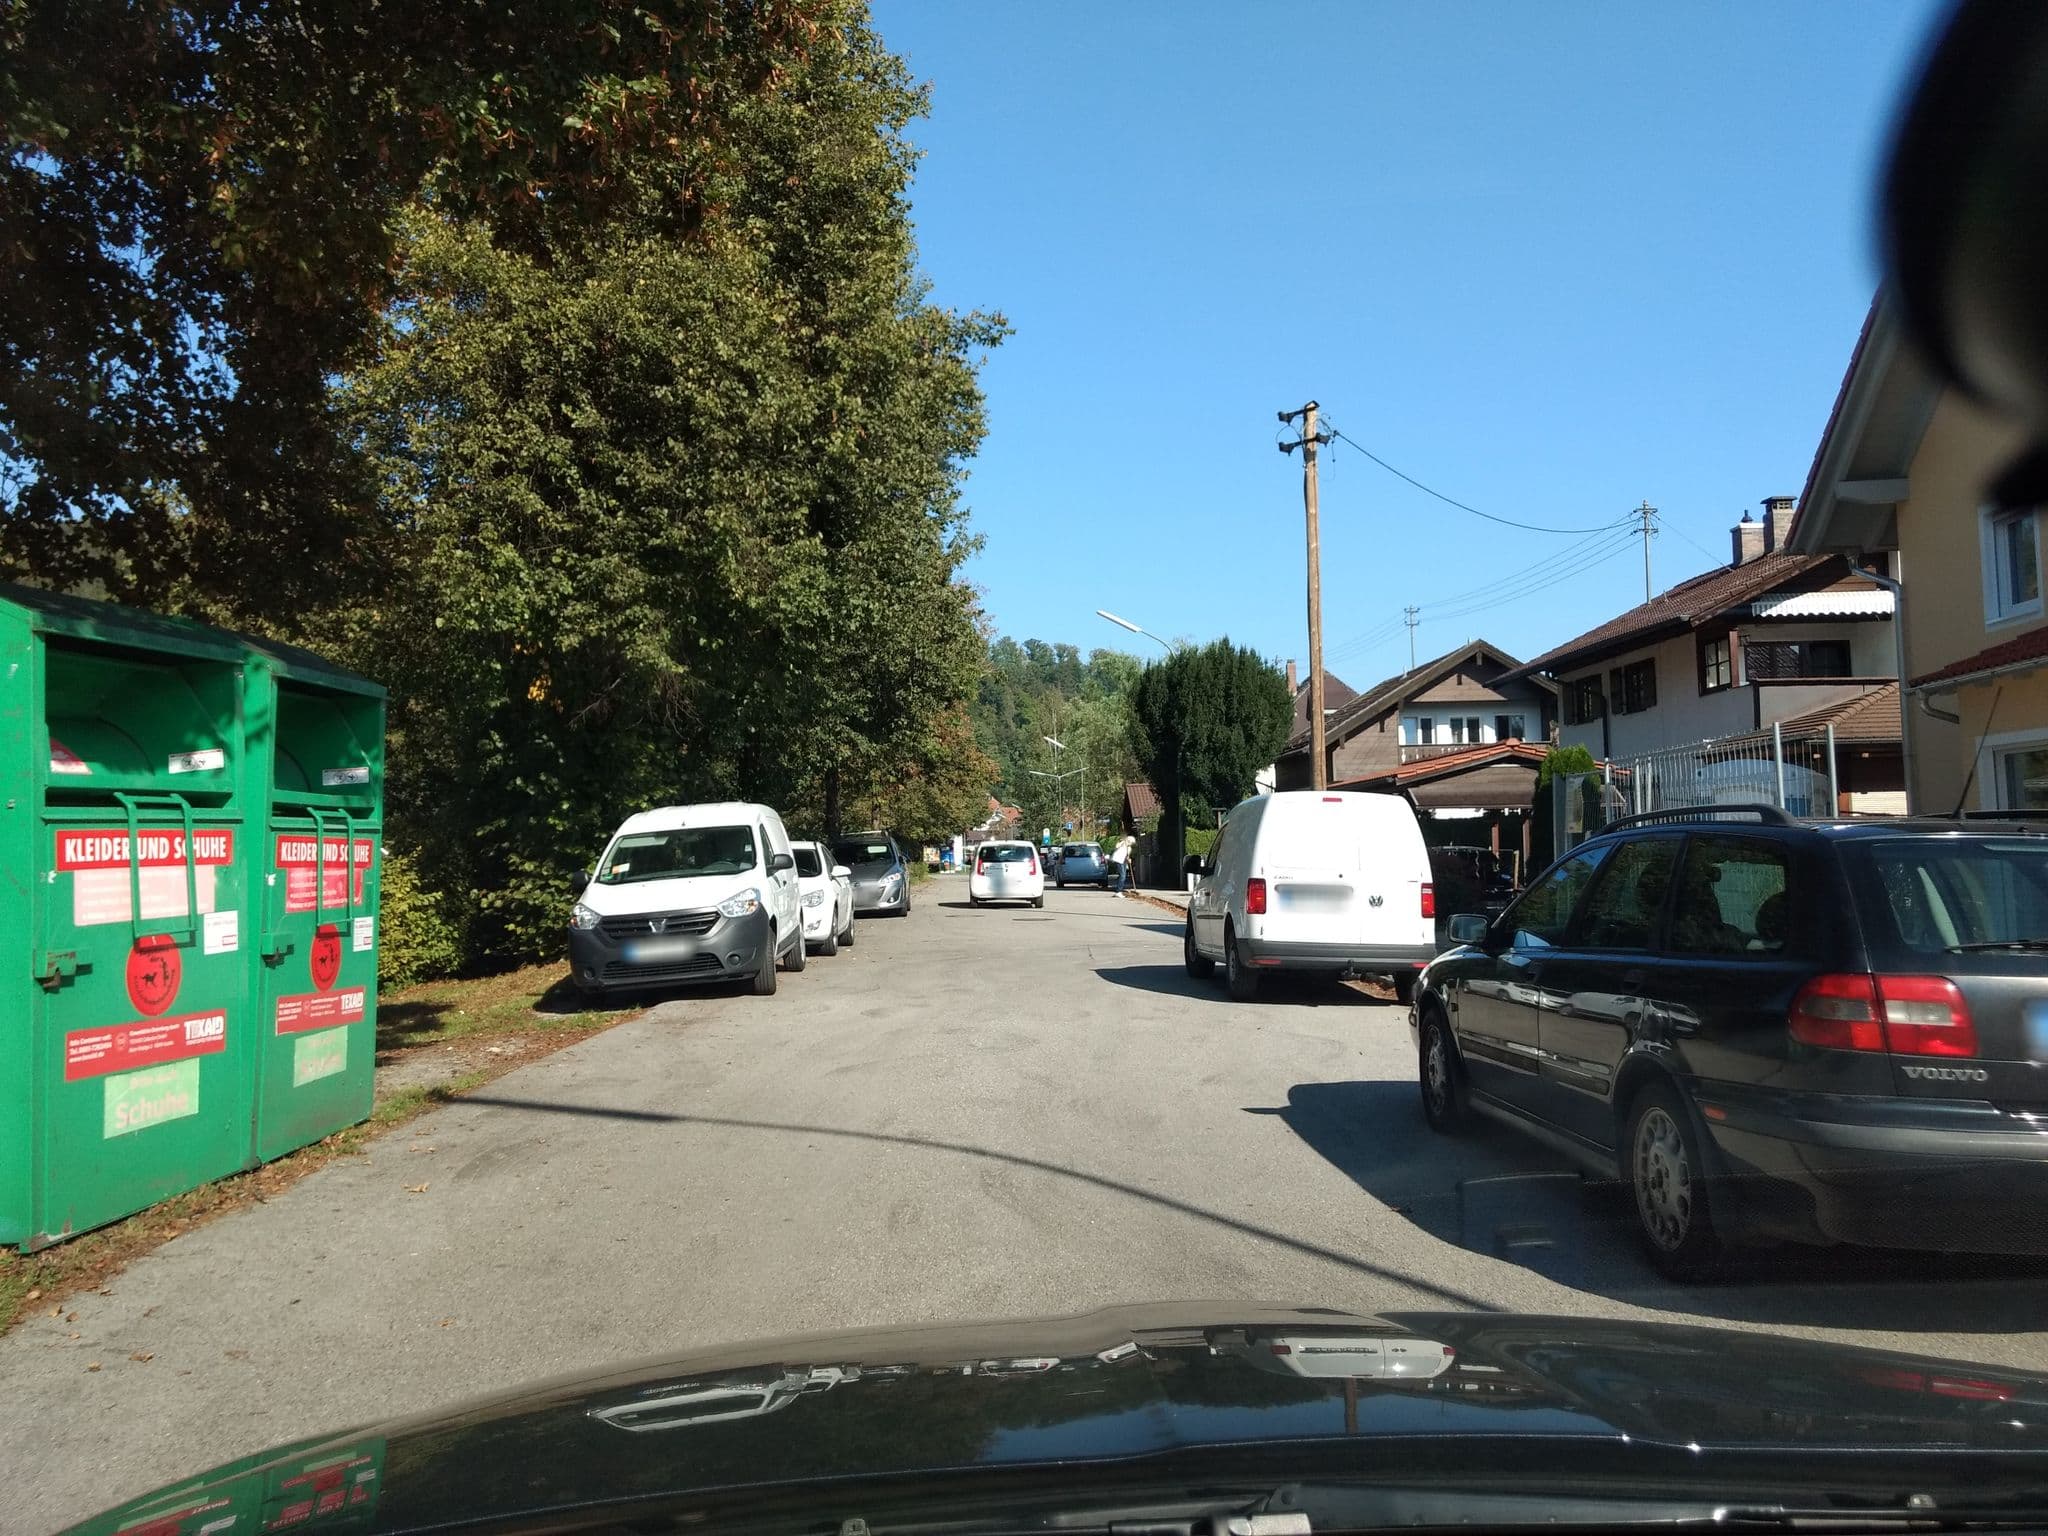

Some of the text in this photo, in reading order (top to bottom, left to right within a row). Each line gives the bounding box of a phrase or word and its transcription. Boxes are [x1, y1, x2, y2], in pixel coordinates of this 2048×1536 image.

[64, 837, 130, 863] KLEIDER
[137, 836, 170, 860] UND
[281, 841, 318, 862] KLEIDER
[340, 843, 370, 863] SCUHE
[340, 992, 364, 1010] TEXAID
[184, 1016, 225, 1041] TEXAID
[1901, 1065, 1988, 1082] VOLVO
[115, 1090, 189, 1129] Schuhe
